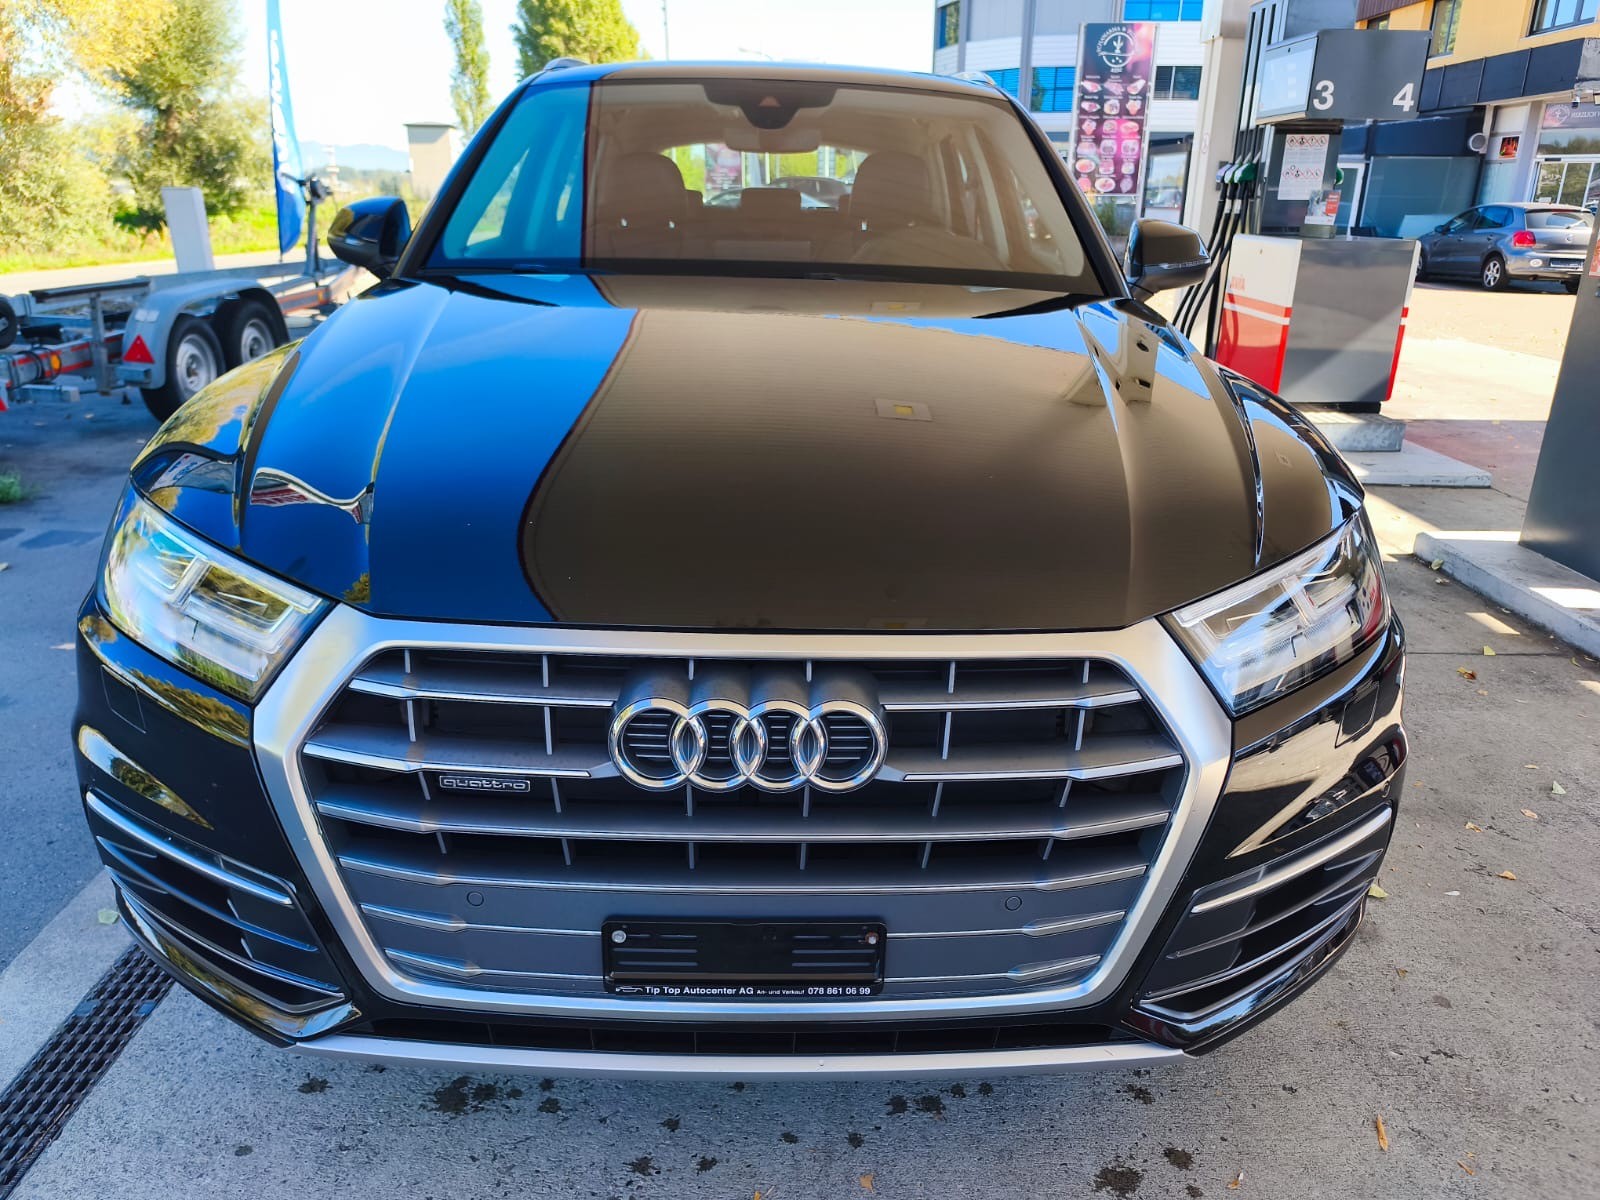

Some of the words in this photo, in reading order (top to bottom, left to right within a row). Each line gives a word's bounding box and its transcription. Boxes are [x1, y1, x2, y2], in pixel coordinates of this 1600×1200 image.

[1312, 80, 1335, 111] 3
[1392, 82, 1415, 112] 4
[443, 777, 526, 790] quattro
[645, 986, 660, 995] Tip
[662, 986, 681, 995] Top
[683, 986, 737, 995] Autocenter
[738, 987, 754, 995] AG
[807, 986, 825, 995] 078
[826, 986, 843, 995] 861
[859, 986, 871, 995] 99
